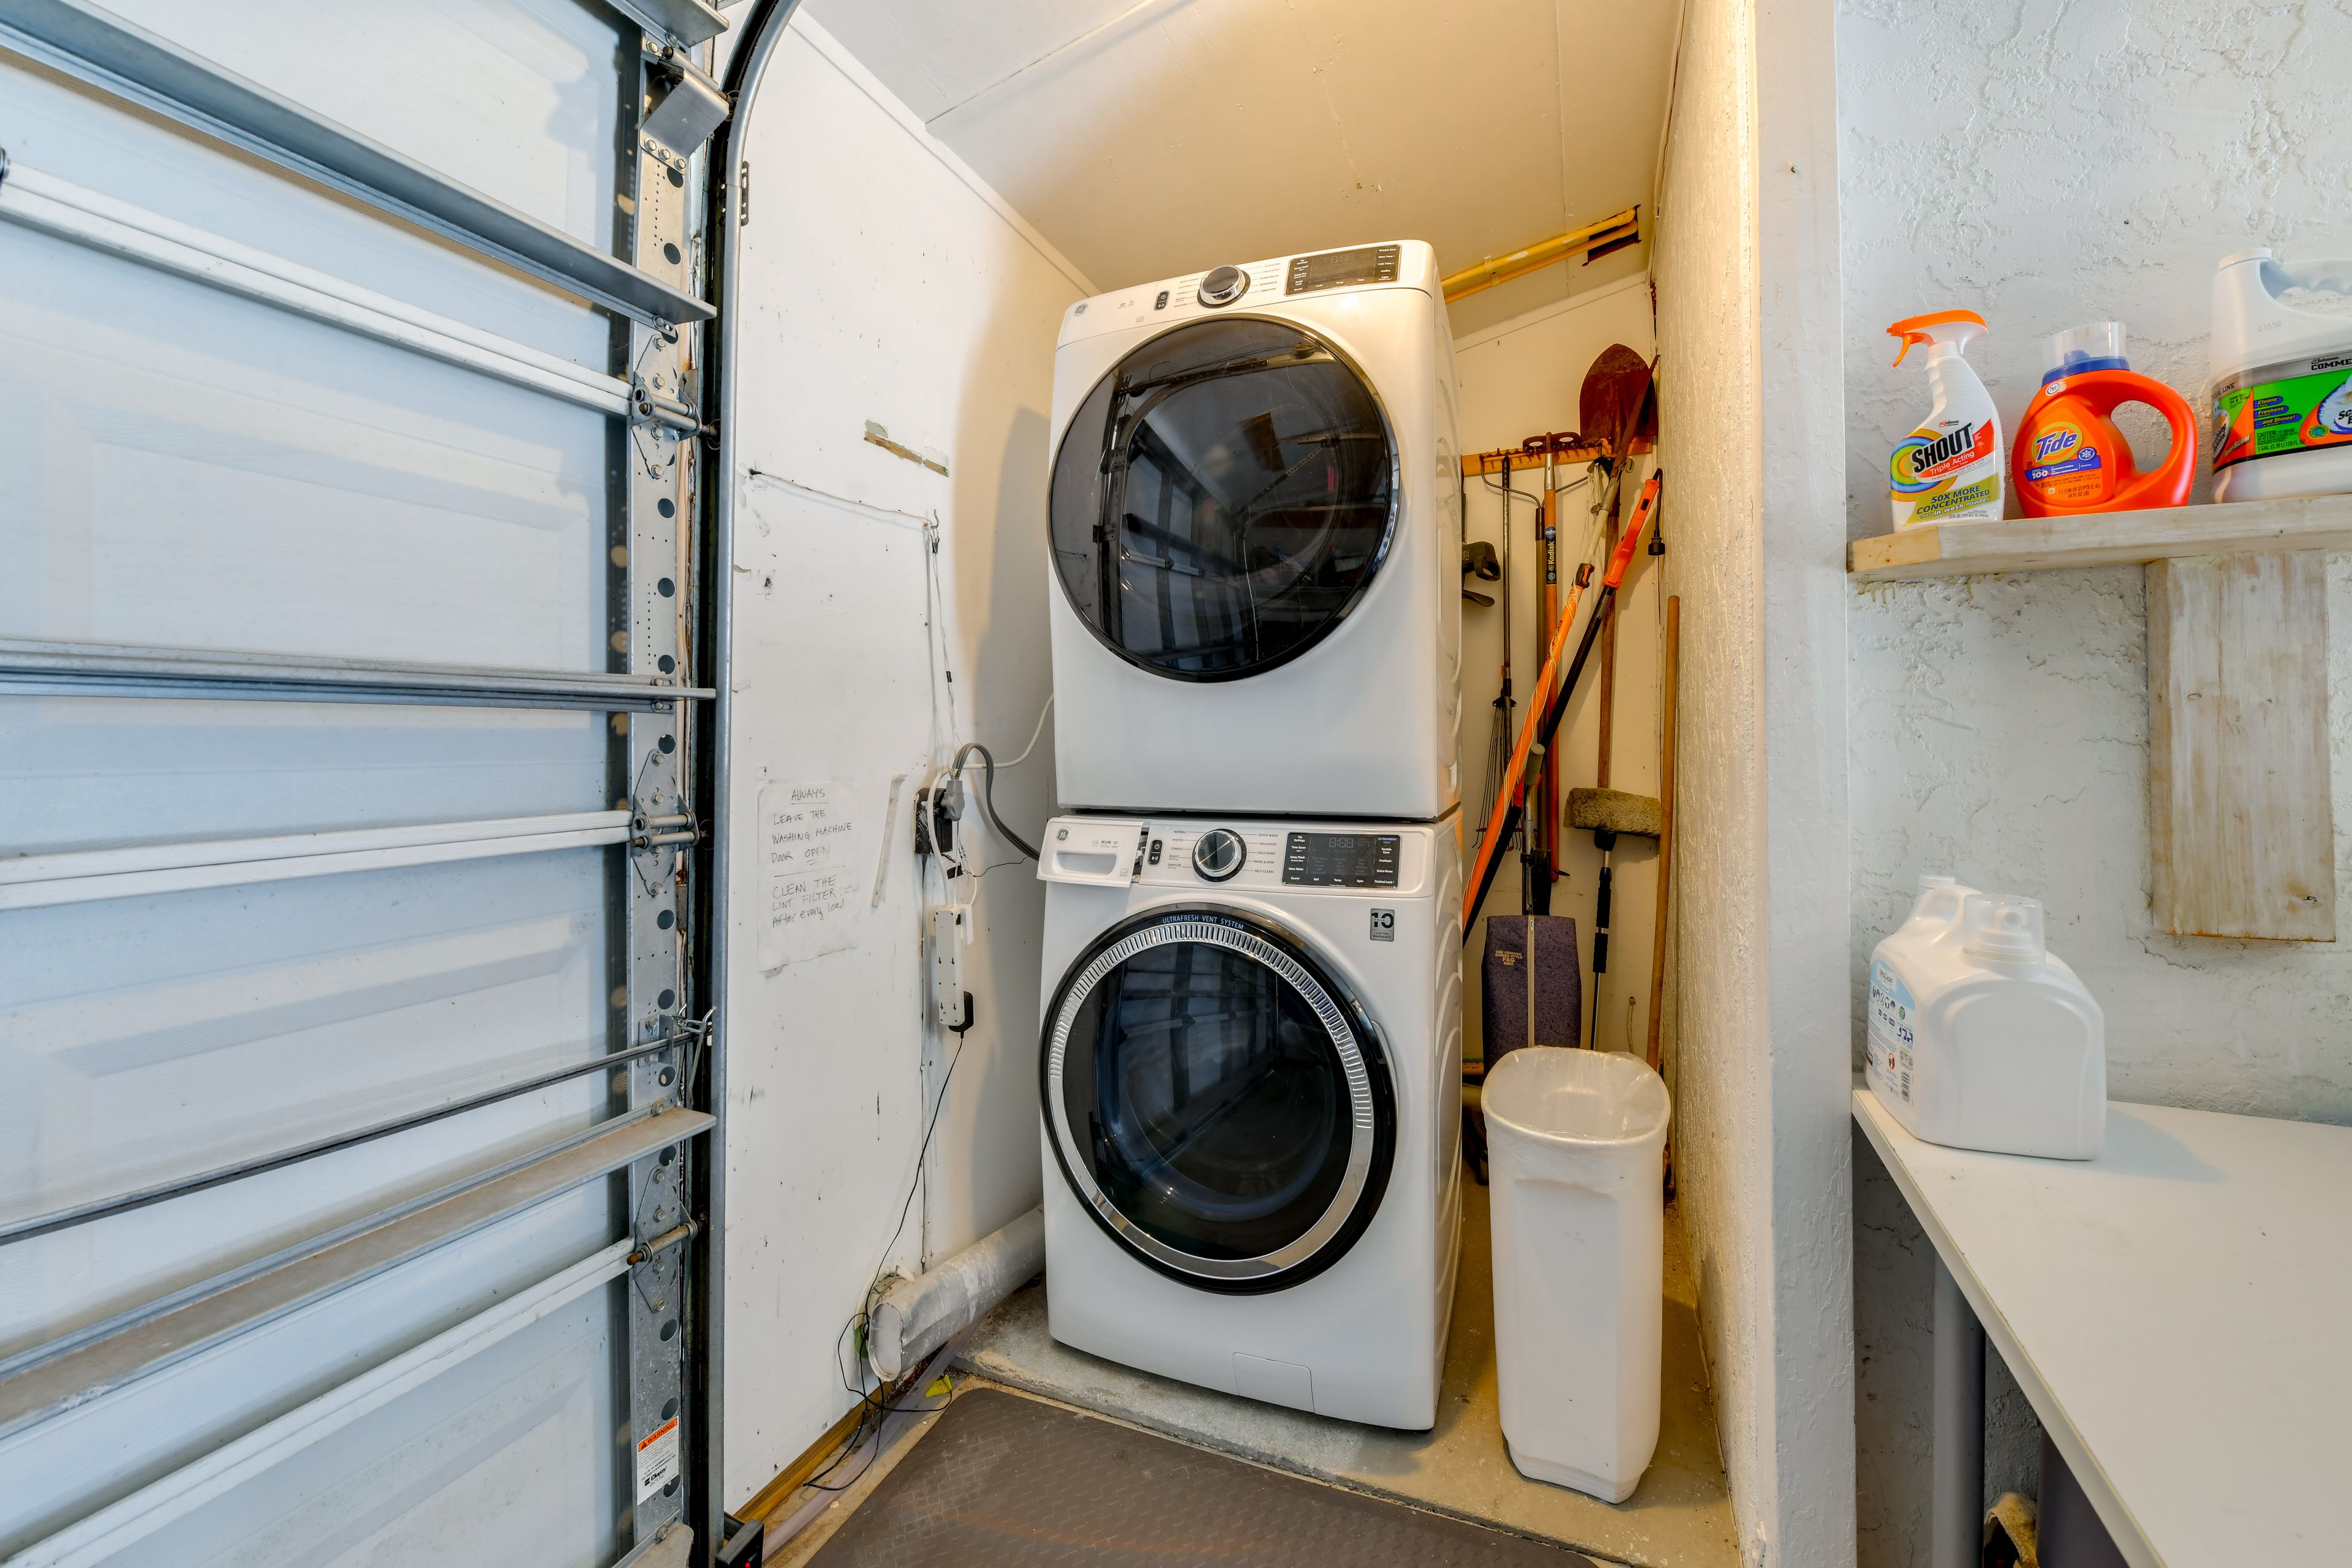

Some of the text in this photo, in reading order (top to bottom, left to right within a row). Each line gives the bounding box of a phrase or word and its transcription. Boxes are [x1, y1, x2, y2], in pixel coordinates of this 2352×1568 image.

[2222, 382, 2235, 393] LINE
[2258, 407, 2285, 415] Freshens
[2274, 414, 2295, 423] Shines!
[1912, 422, 1972, 473] SHOUT
[2035, 429, 2078, 462] Tide
[1930, 461, 1951, 475] Triple
[1952, 451, 1975, 466] Acting
[1917, 489, 1990, 514] CONCENTRATED
[1931, 485, 1981, 504] 50X MORE
[1965, 496, 1990, 508] Powder
[791, 789, 826, 801] ALWAYS
[774, 809, 826, 826] LEAVE THE
[772, 822, 853, 845] WASHING MACHINE
[771, 843, 831, 864] DOOR OPEN
[772, 874, 838, 899] CLEAN THE
[772, 897, 794, 911] LINT
[802, 888, 837, 905] FILTER
[800, 907, 824, 921] every
[827, 898, 844, 913] load
[1163, 914, 1199, 924] ULTRAFRESH
[1221, 918, 1244, 930] SYSTEM
[1371, 913, 1394, 929] 10
[647, 1422, 674, 1444] WARNING
